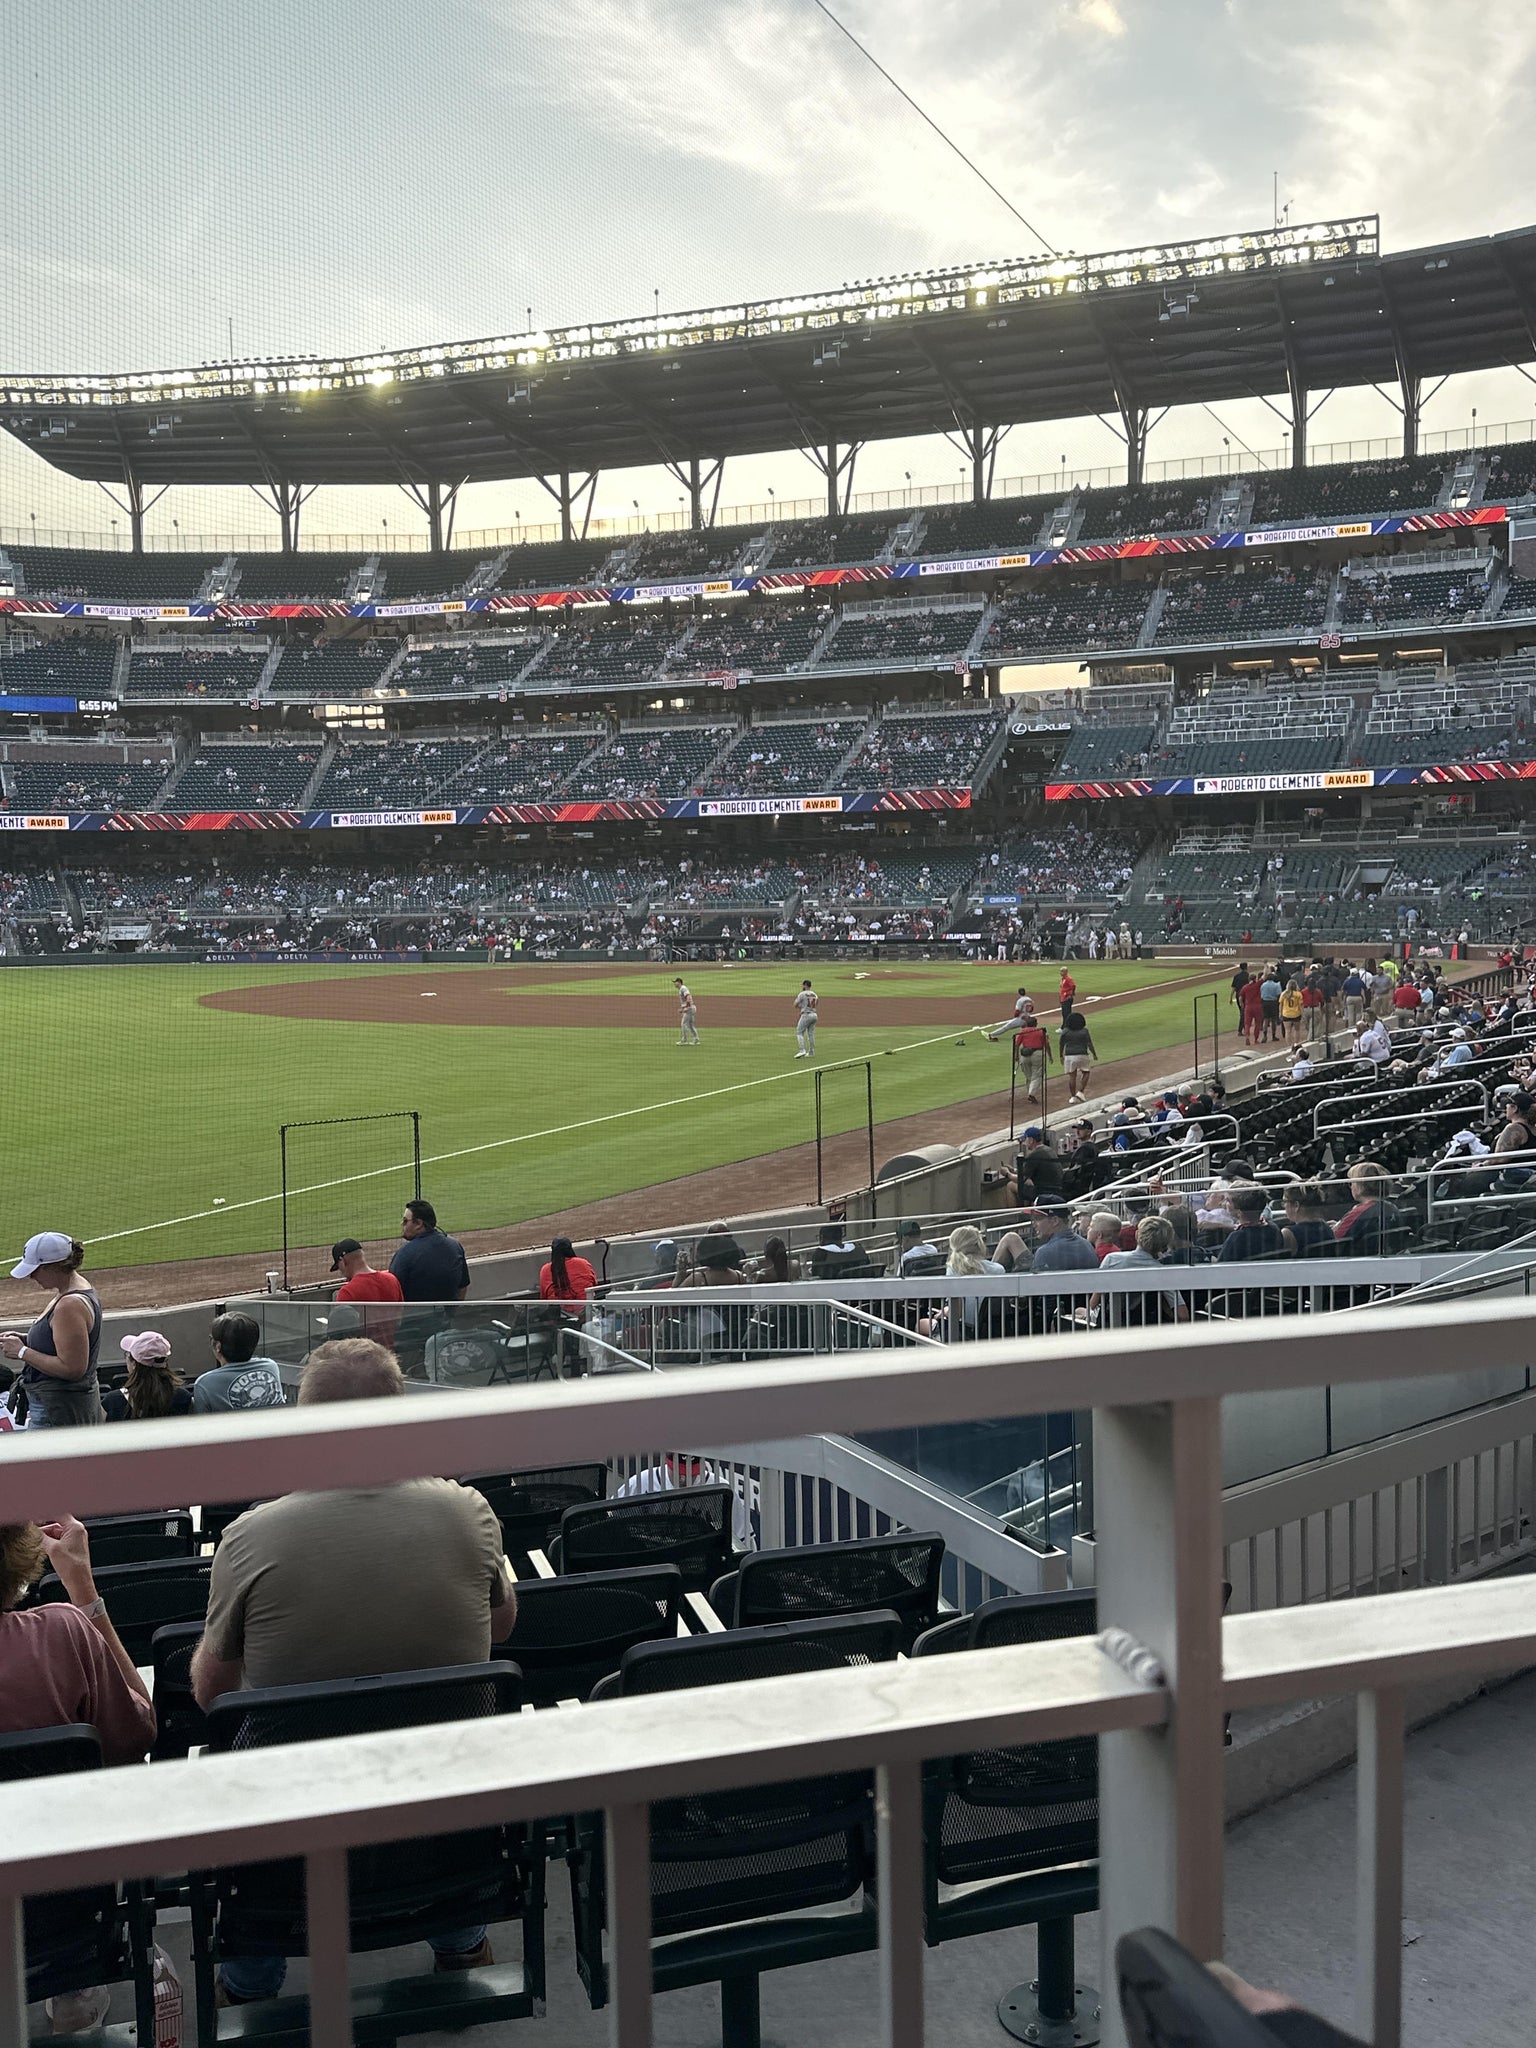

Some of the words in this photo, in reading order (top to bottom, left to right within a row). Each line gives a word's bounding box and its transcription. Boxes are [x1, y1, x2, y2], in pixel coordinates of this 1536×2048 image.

[1263, 531, 1296, 543] ROBERTO
[1298, 528, 1335, 539] CLEMENTE
[1338, 525, 1367, 534] AWARD
[936, 562, 965, 572] ROBERTO
[966, 559, 998, 569] CLEMENTE
[1001, 557, 1026, 565] AWARD
[648, 587, 674, 597] ROBERTO
[675, 584, 704, 595] CLEMENTE
[706, 583, 729, 591] AWARD
[100, 606, 129, 616] ROBERTO
[130, 607, 160, 616] CLEMENTE
[390, 606, 414, 615] ROBERTO
[414, 604, 440, 614] CLEMENTE
[443, 603, 463, 611] AWARD
[1320, 632, 1341, 649] 25
[954, 660, 970, 675] 21
[723, 675, 737, 690] 10
[499, 689, 508, 703] 6
[79, 700, 101, 711] 6:55
[101, 701, 118, 712] PM
[250, 698, 260, 711] 3
[1028, 722, 1072, 732] LEXUS
[1220, 777, 1266, 791] ROBERTO
[1269, 775, 1322, 789] CLEMENTE
[1328, 774, 1367, 785] AWARD
[720, 801, 756, 813] ROBERTO
[759, 800, 801, 812] CLEMENTE
[805, 799, 837, 809] AWARD
[30, 819, 63, 827] AWARD
[350, 814, 381, 825] ROBERTO
[384, 813, 420, 824] CLEMENTE
[424, 813, 452, 821] AWARD
[1212, 947, 1237, 956] Mobile
[230, 1371, 275, 1393] ROCKY
